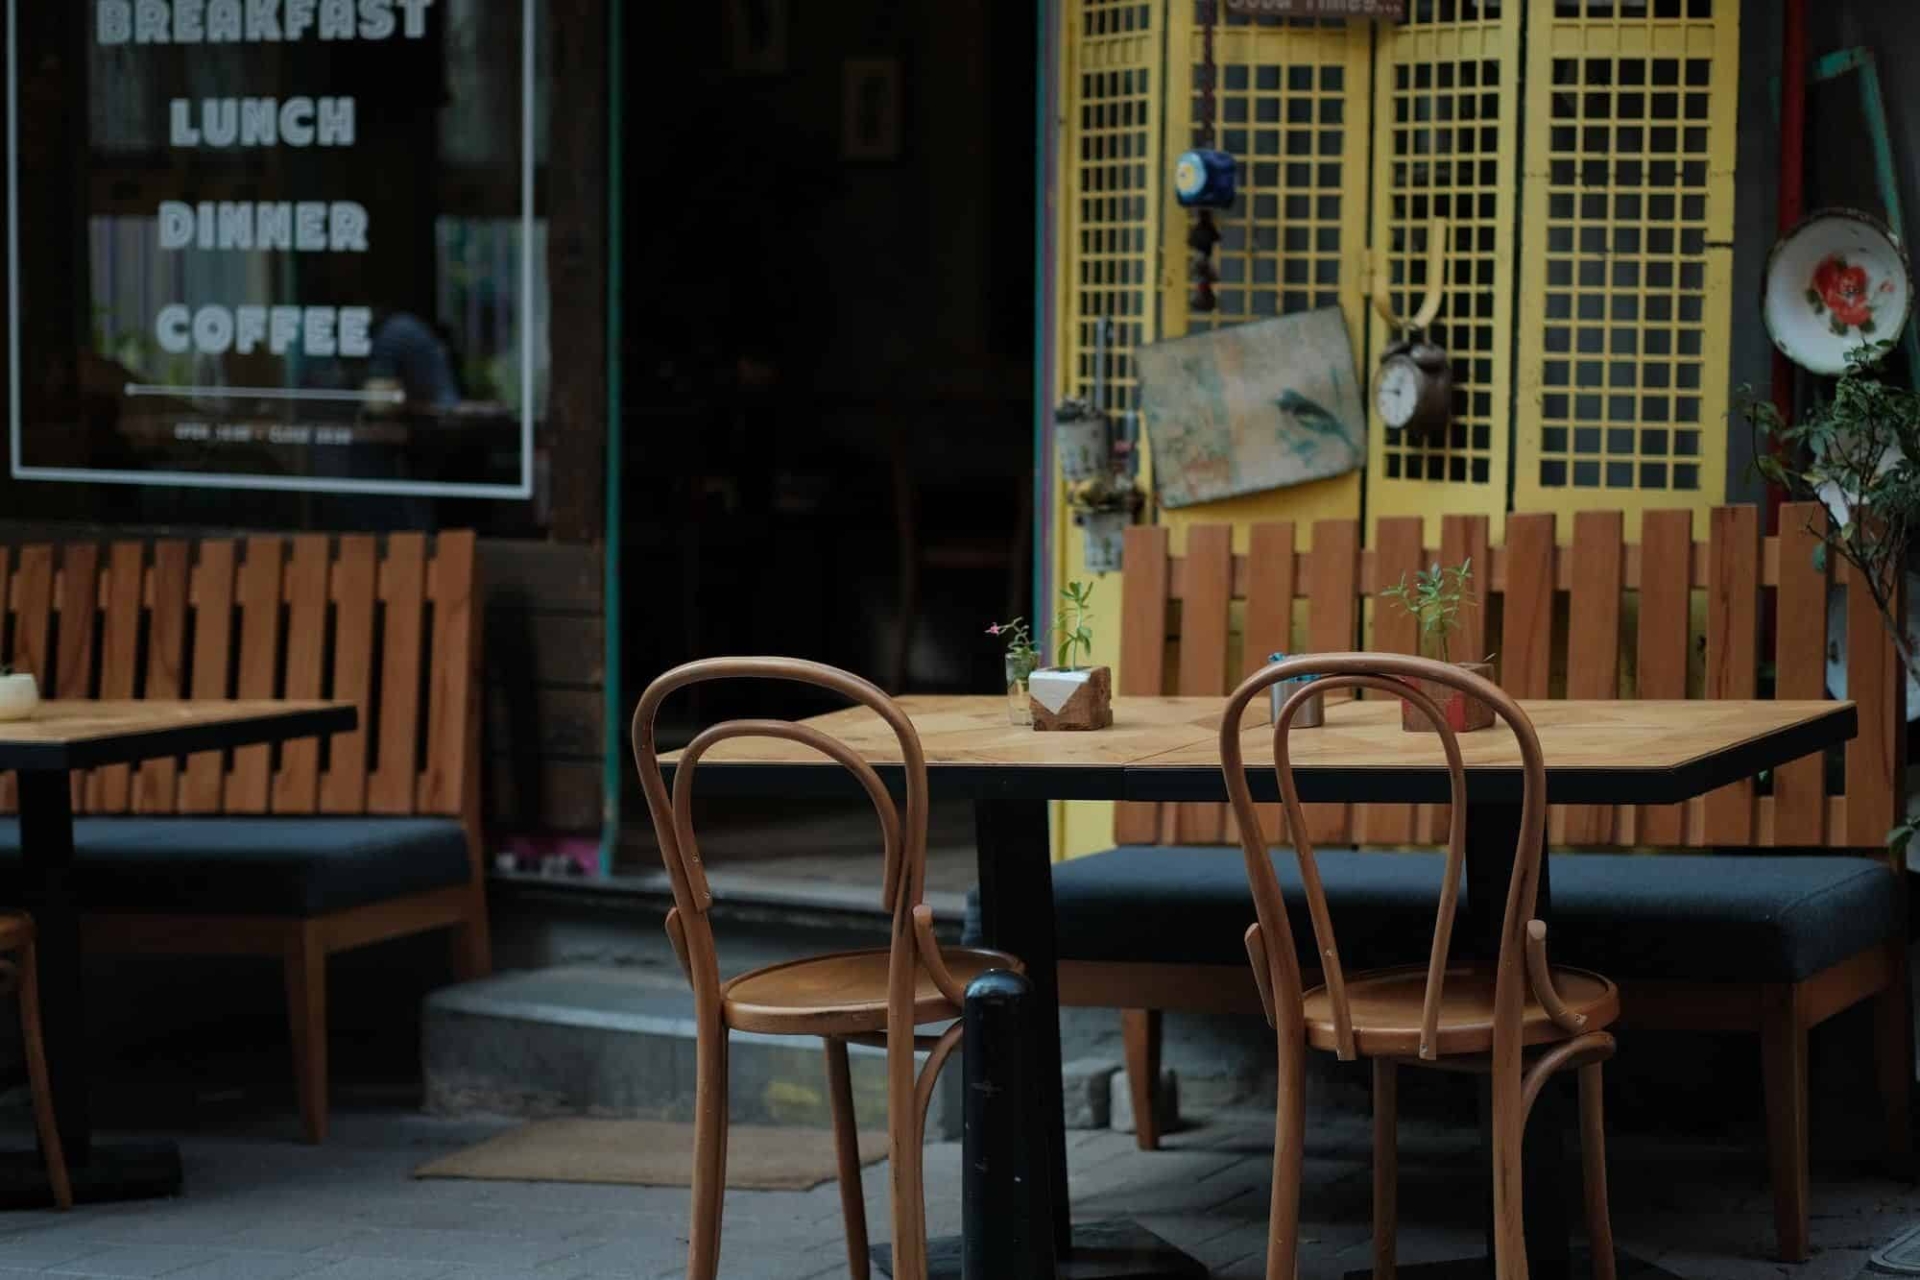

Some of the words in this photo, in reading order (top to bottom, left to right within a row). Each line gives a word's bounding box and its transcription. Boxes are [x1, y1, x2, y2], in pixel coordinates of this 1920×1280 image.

[96, 0, 434, 45] BREAKFAST
[169, 97, 355, 147] LUNCH
[157, 200, 369, 252] DINNER
[155, 303, 373, 357] COFFEE
